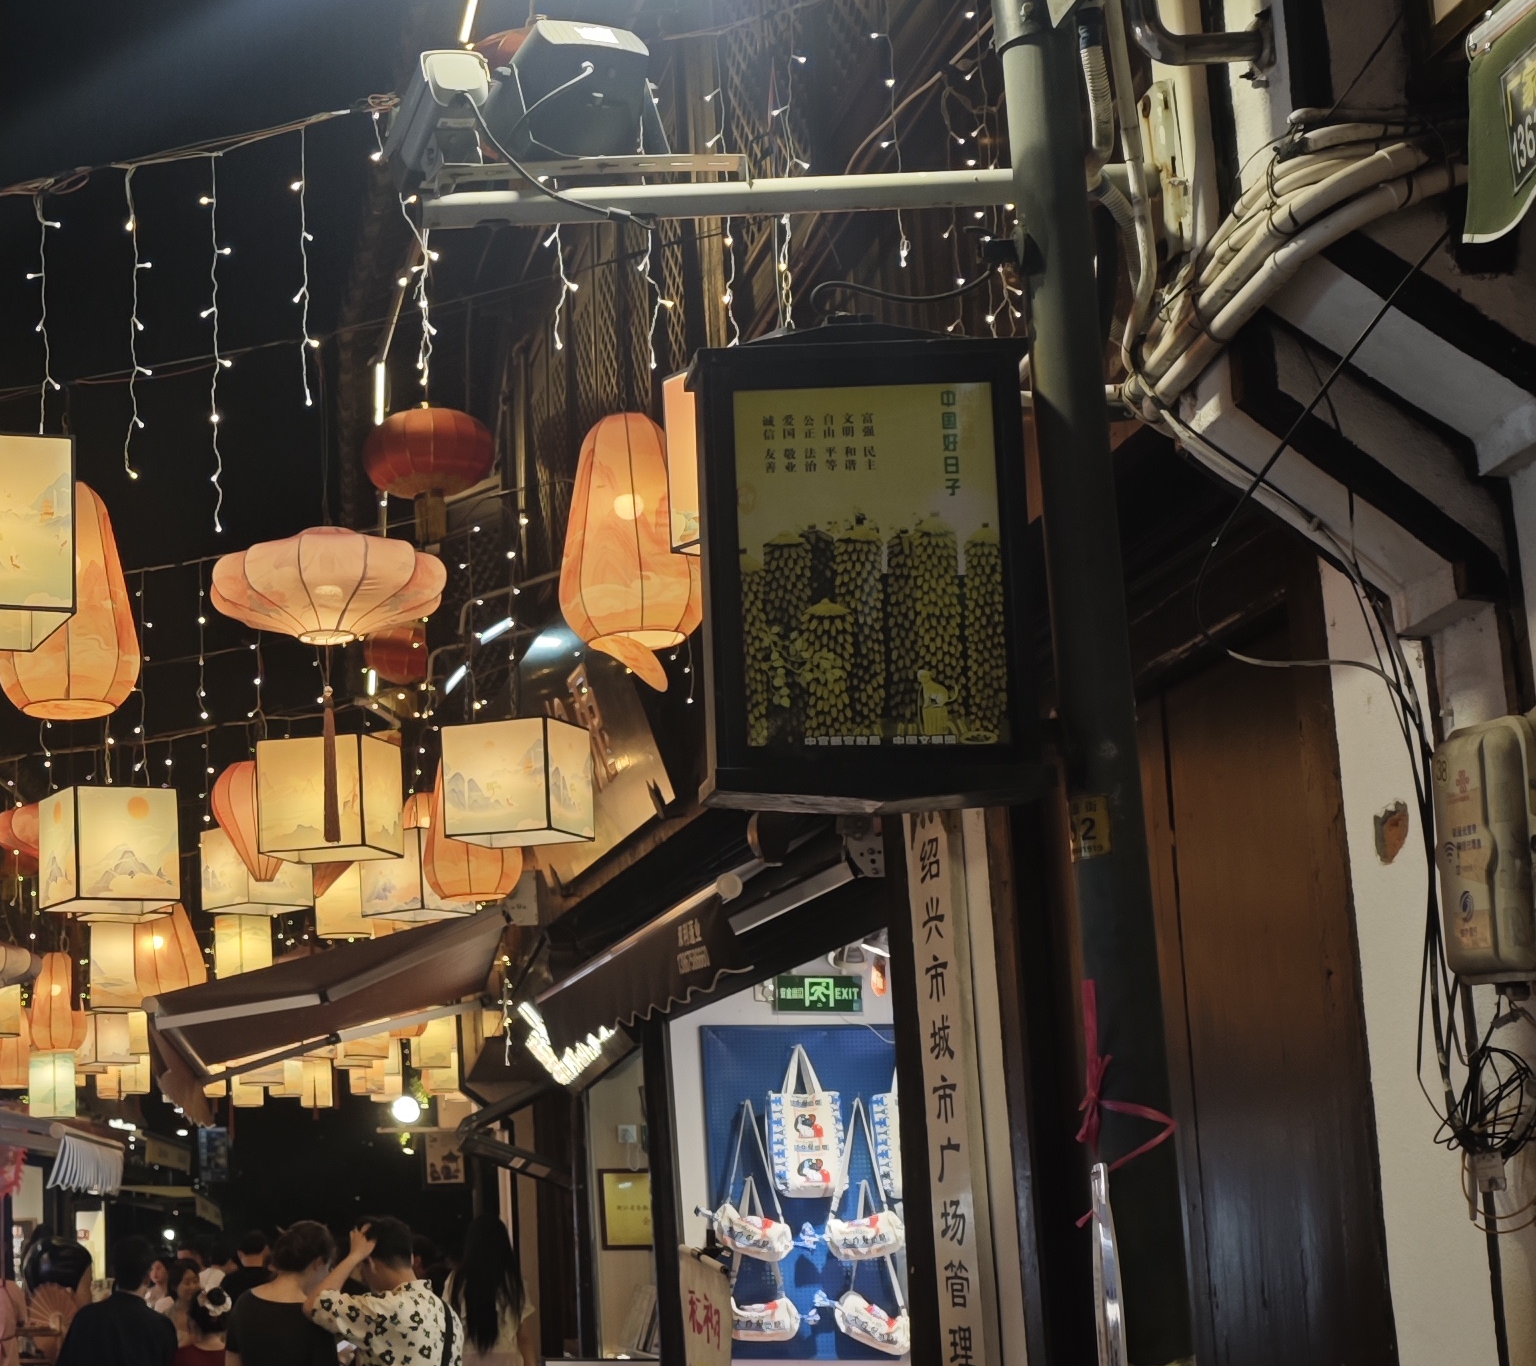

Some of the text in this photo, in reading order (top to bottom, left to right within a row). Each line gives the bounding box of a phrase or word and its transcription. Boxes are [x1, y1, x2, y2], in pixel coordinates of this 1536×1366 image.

[941, 390, 960, 496] 中国好日子
[834, 987, 860, 1000] EXIT
